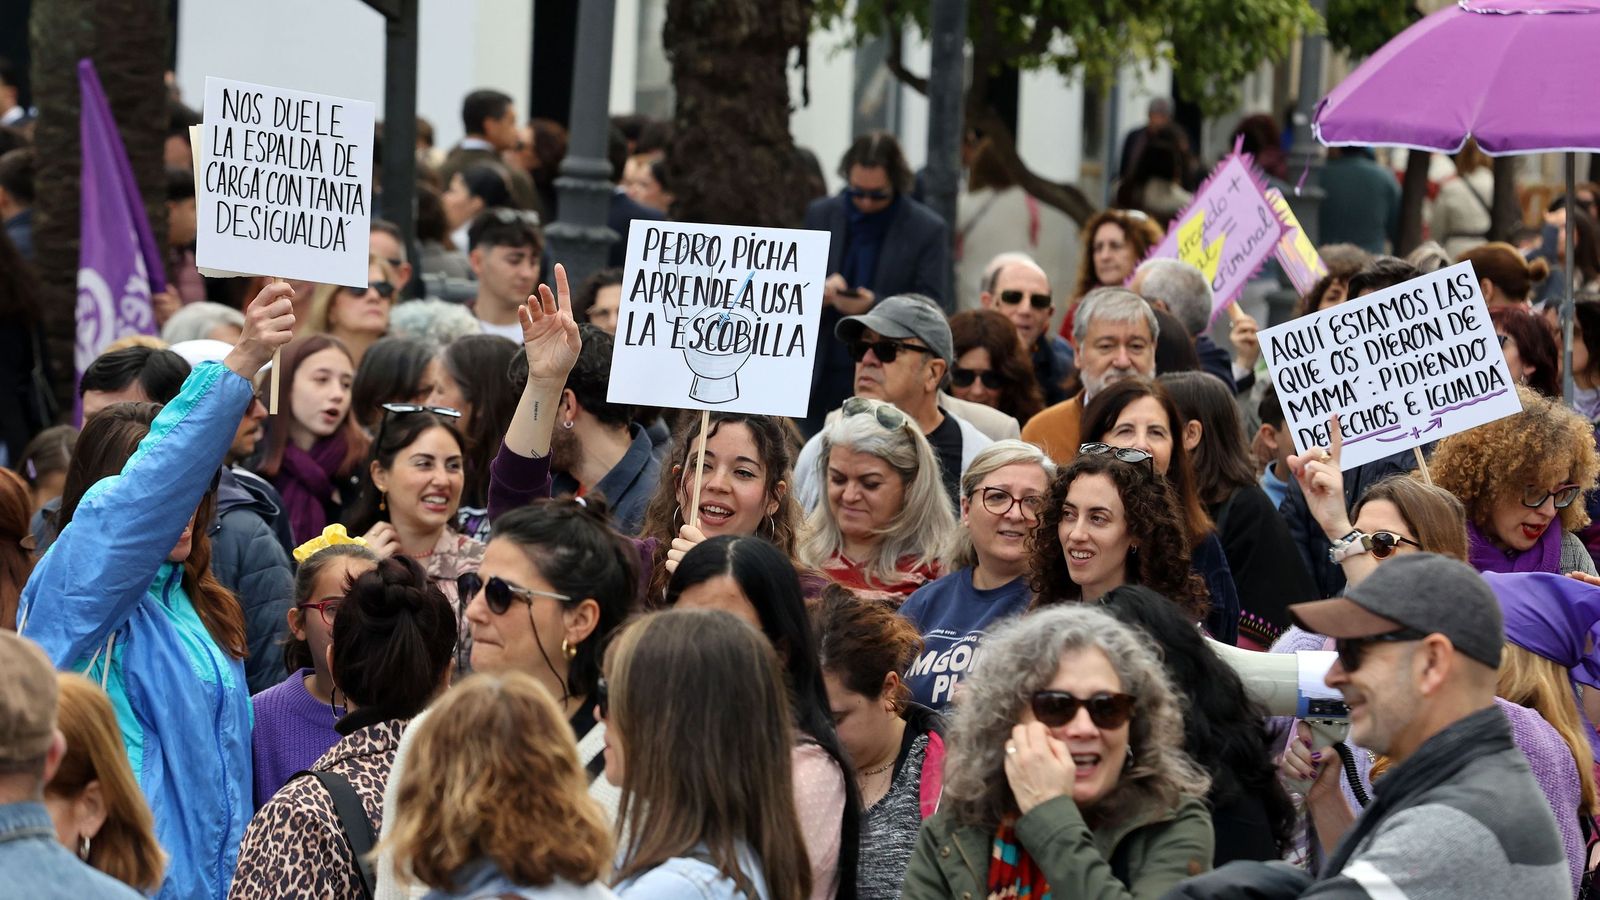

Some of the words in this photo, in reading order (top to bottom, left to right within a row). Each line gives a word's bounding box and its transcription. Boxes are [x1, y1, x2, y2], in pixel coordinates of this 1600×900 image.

[222, 88, 263, 125] NOS
[273, 96, 344, 138] DUELE
[213, 125, 233, 159] LA
[243, 129, 324, 173] ESPALDA
[333, 142, 358, 178] DE
[266, 171, 302, 207] CON
[306, 176, 365, 216] TANTA
[642, 227, 727, 274] PEDRO,
[1211, 205, 1274, 293] criminal
[629, 268, 738, 310] APRENDE
[740, 278, 755, 311] A
[625, 311, 656, 347] LA
[1271, 317, 1325, 366] AQUÍ
[1329, 288, 1429, 345] ESTAMOS
[1432, 273, 1474, 310] LAS
[1278, 358, 1325, 394] QUE
[1330, 346, 1359, 376] OS
[1448, 305, 1482, 335] DE
[1404, 391, 1421, 417] E
